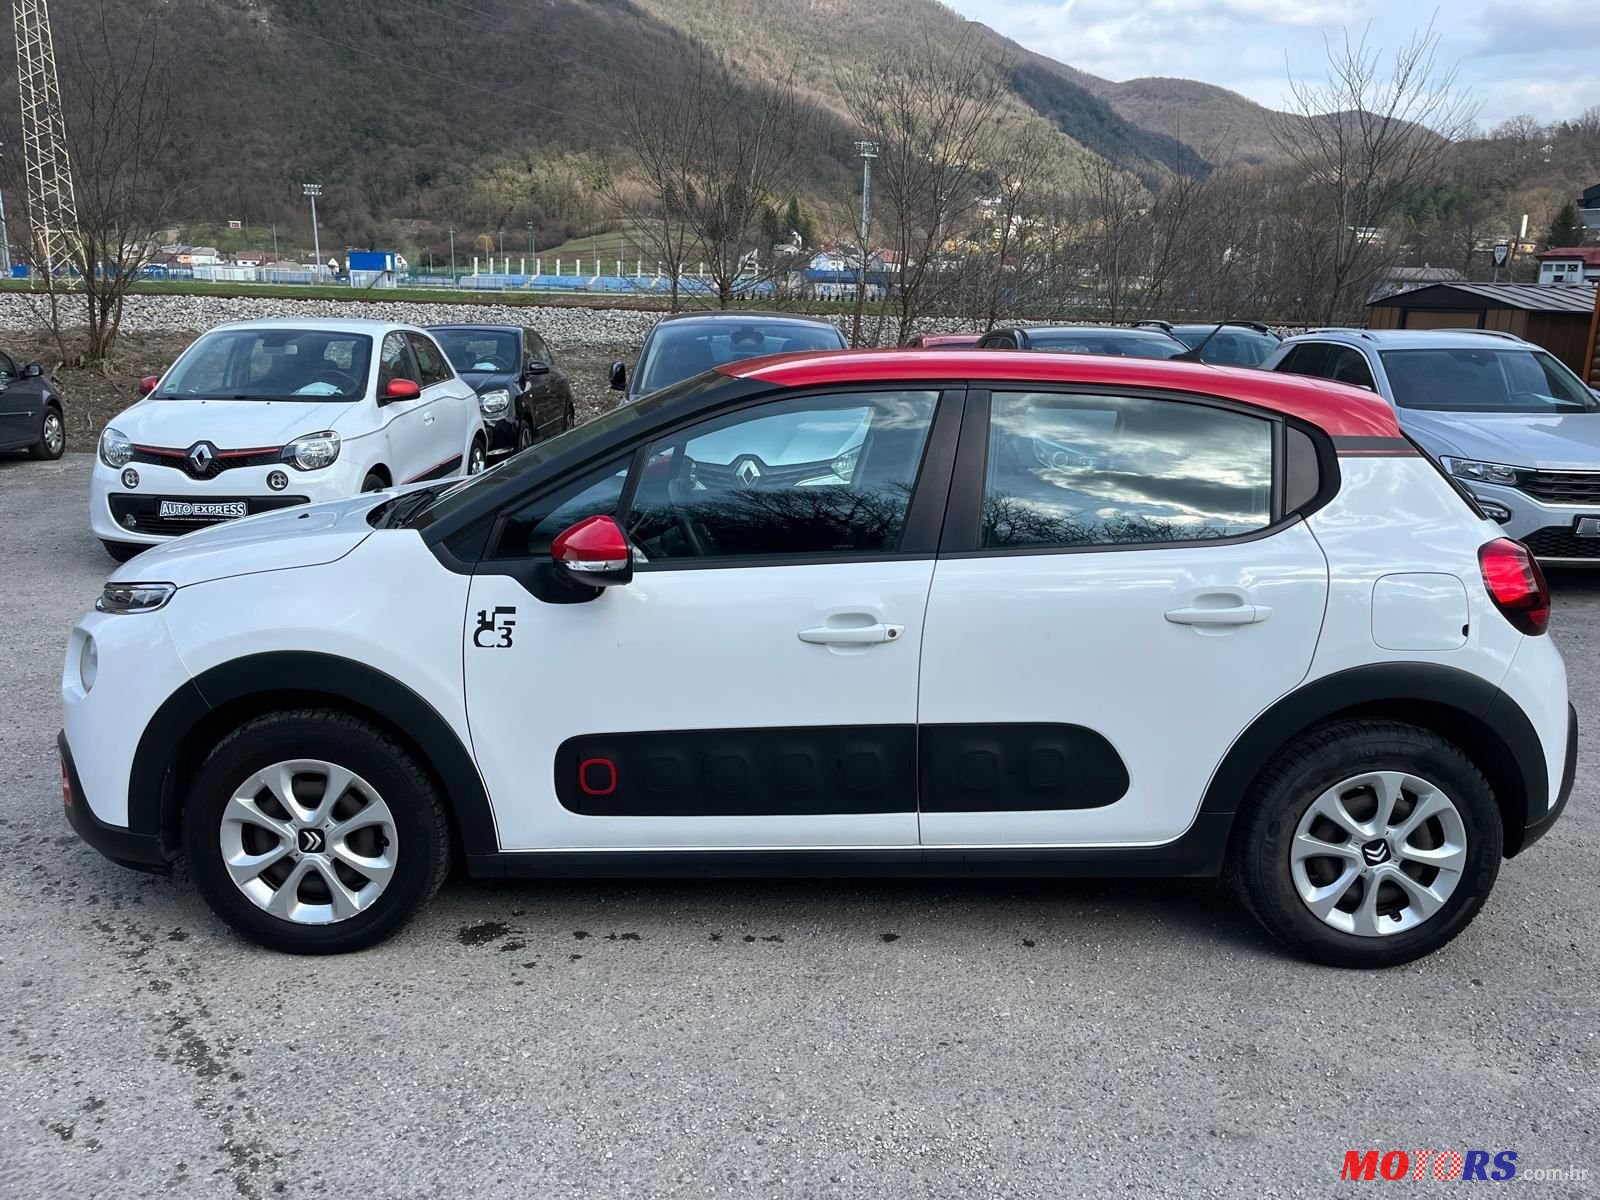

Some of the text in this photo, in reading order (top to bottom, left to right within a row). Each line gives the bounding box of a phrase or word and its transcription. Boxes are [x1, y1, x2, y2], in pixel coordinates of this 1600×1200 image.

[160, 501, 246, 516] AUTO EXPRESS
[473, 625, 513, 648] C3
